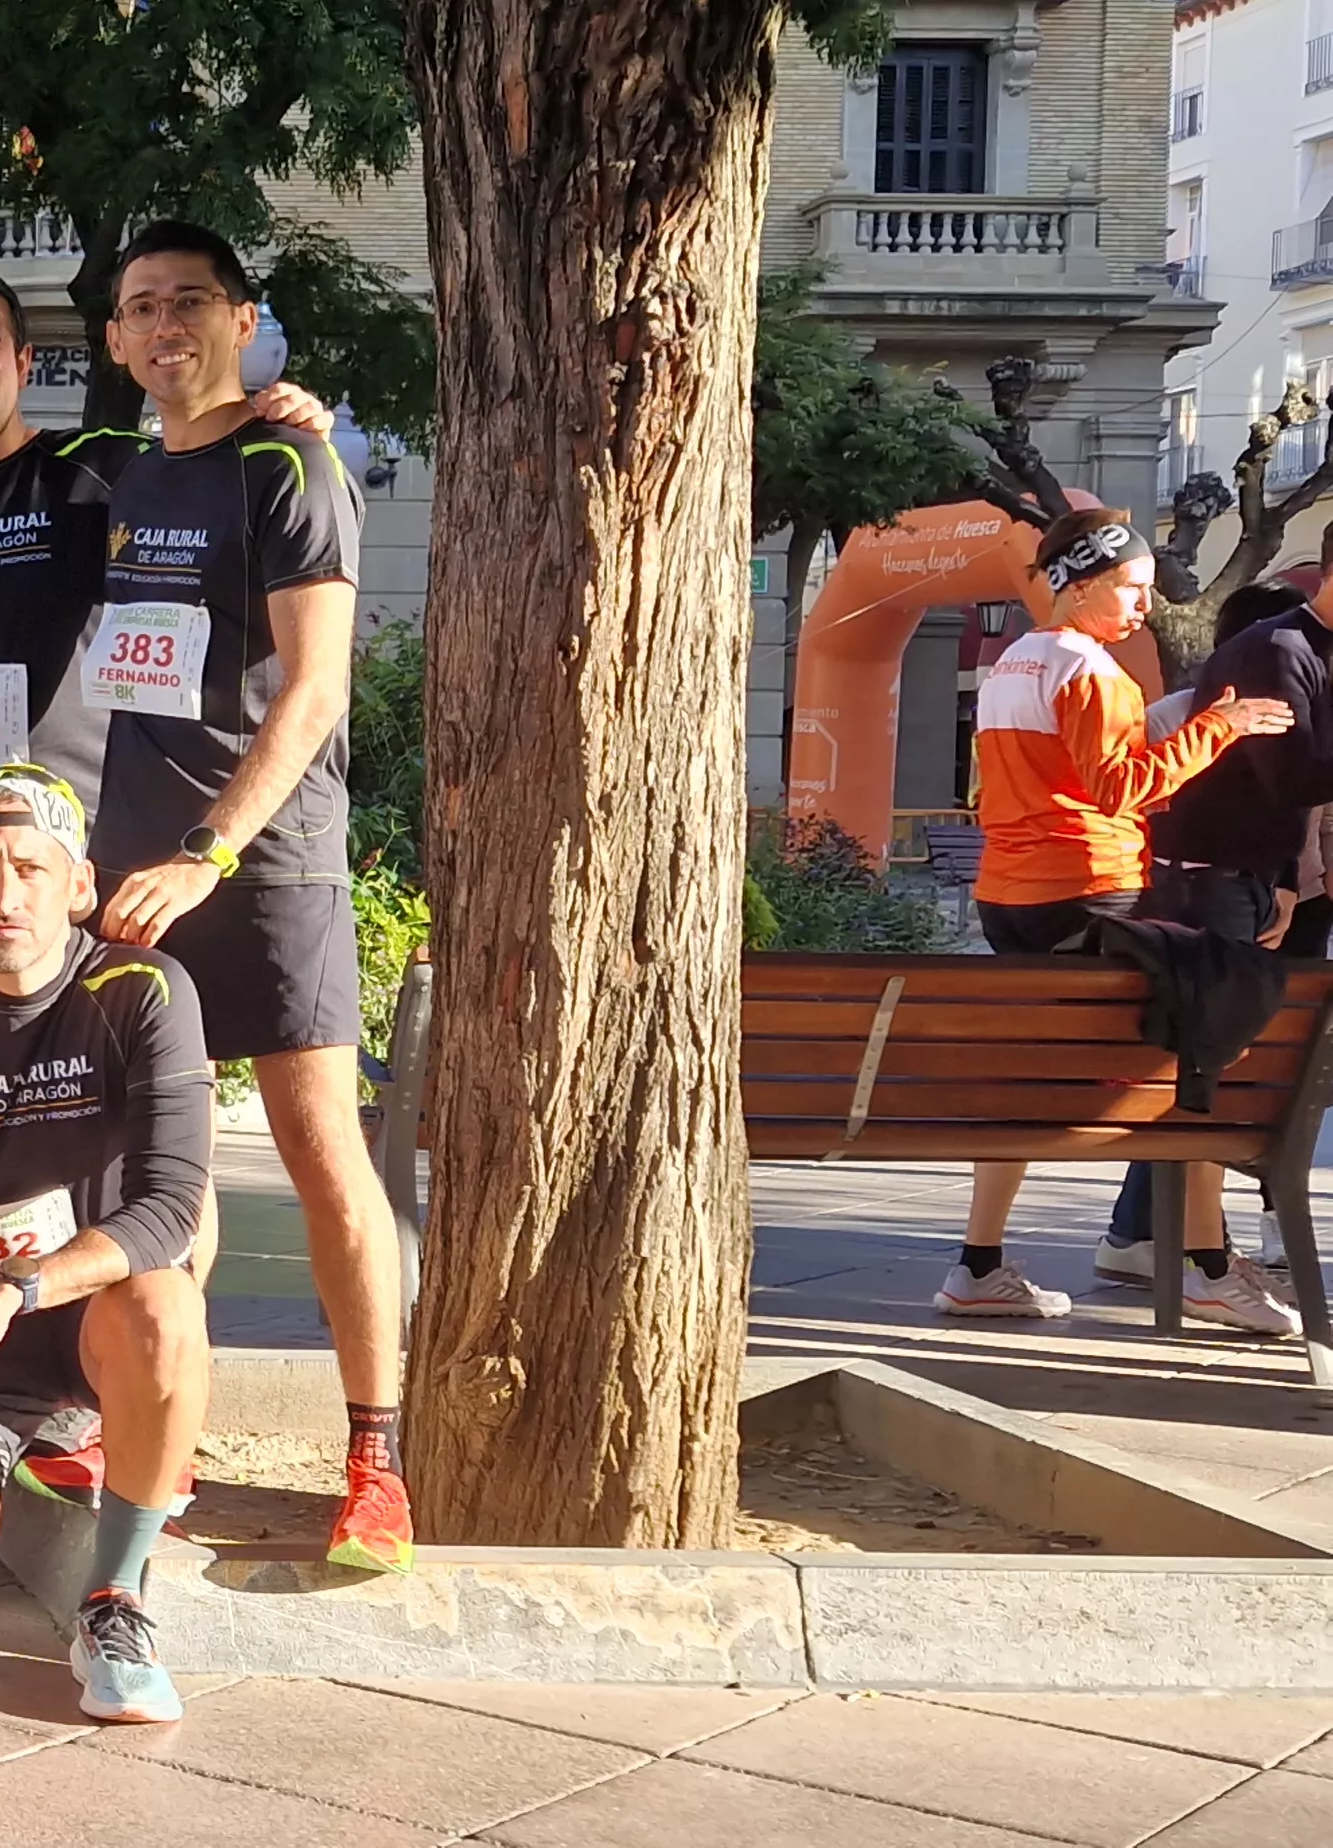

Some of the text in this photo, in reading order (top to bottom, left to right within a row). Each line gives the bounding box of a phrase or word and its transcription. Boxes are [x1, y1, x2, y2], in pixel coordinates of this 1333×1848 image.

[134, 527, 209, 548] CAJA RURAL
[954, 519, 1002, 539] Huesca
[137, 550, 196, 565] DE ARAGÓN
[110, 632, 175, 667] 383
[98, 667, 181, 688] FERNANDO
[114, 684, 136, 700] 8K
[27, 1055, 93, 1084] RURAL
[15, 1082, 82, 1106] ARAGÓN
